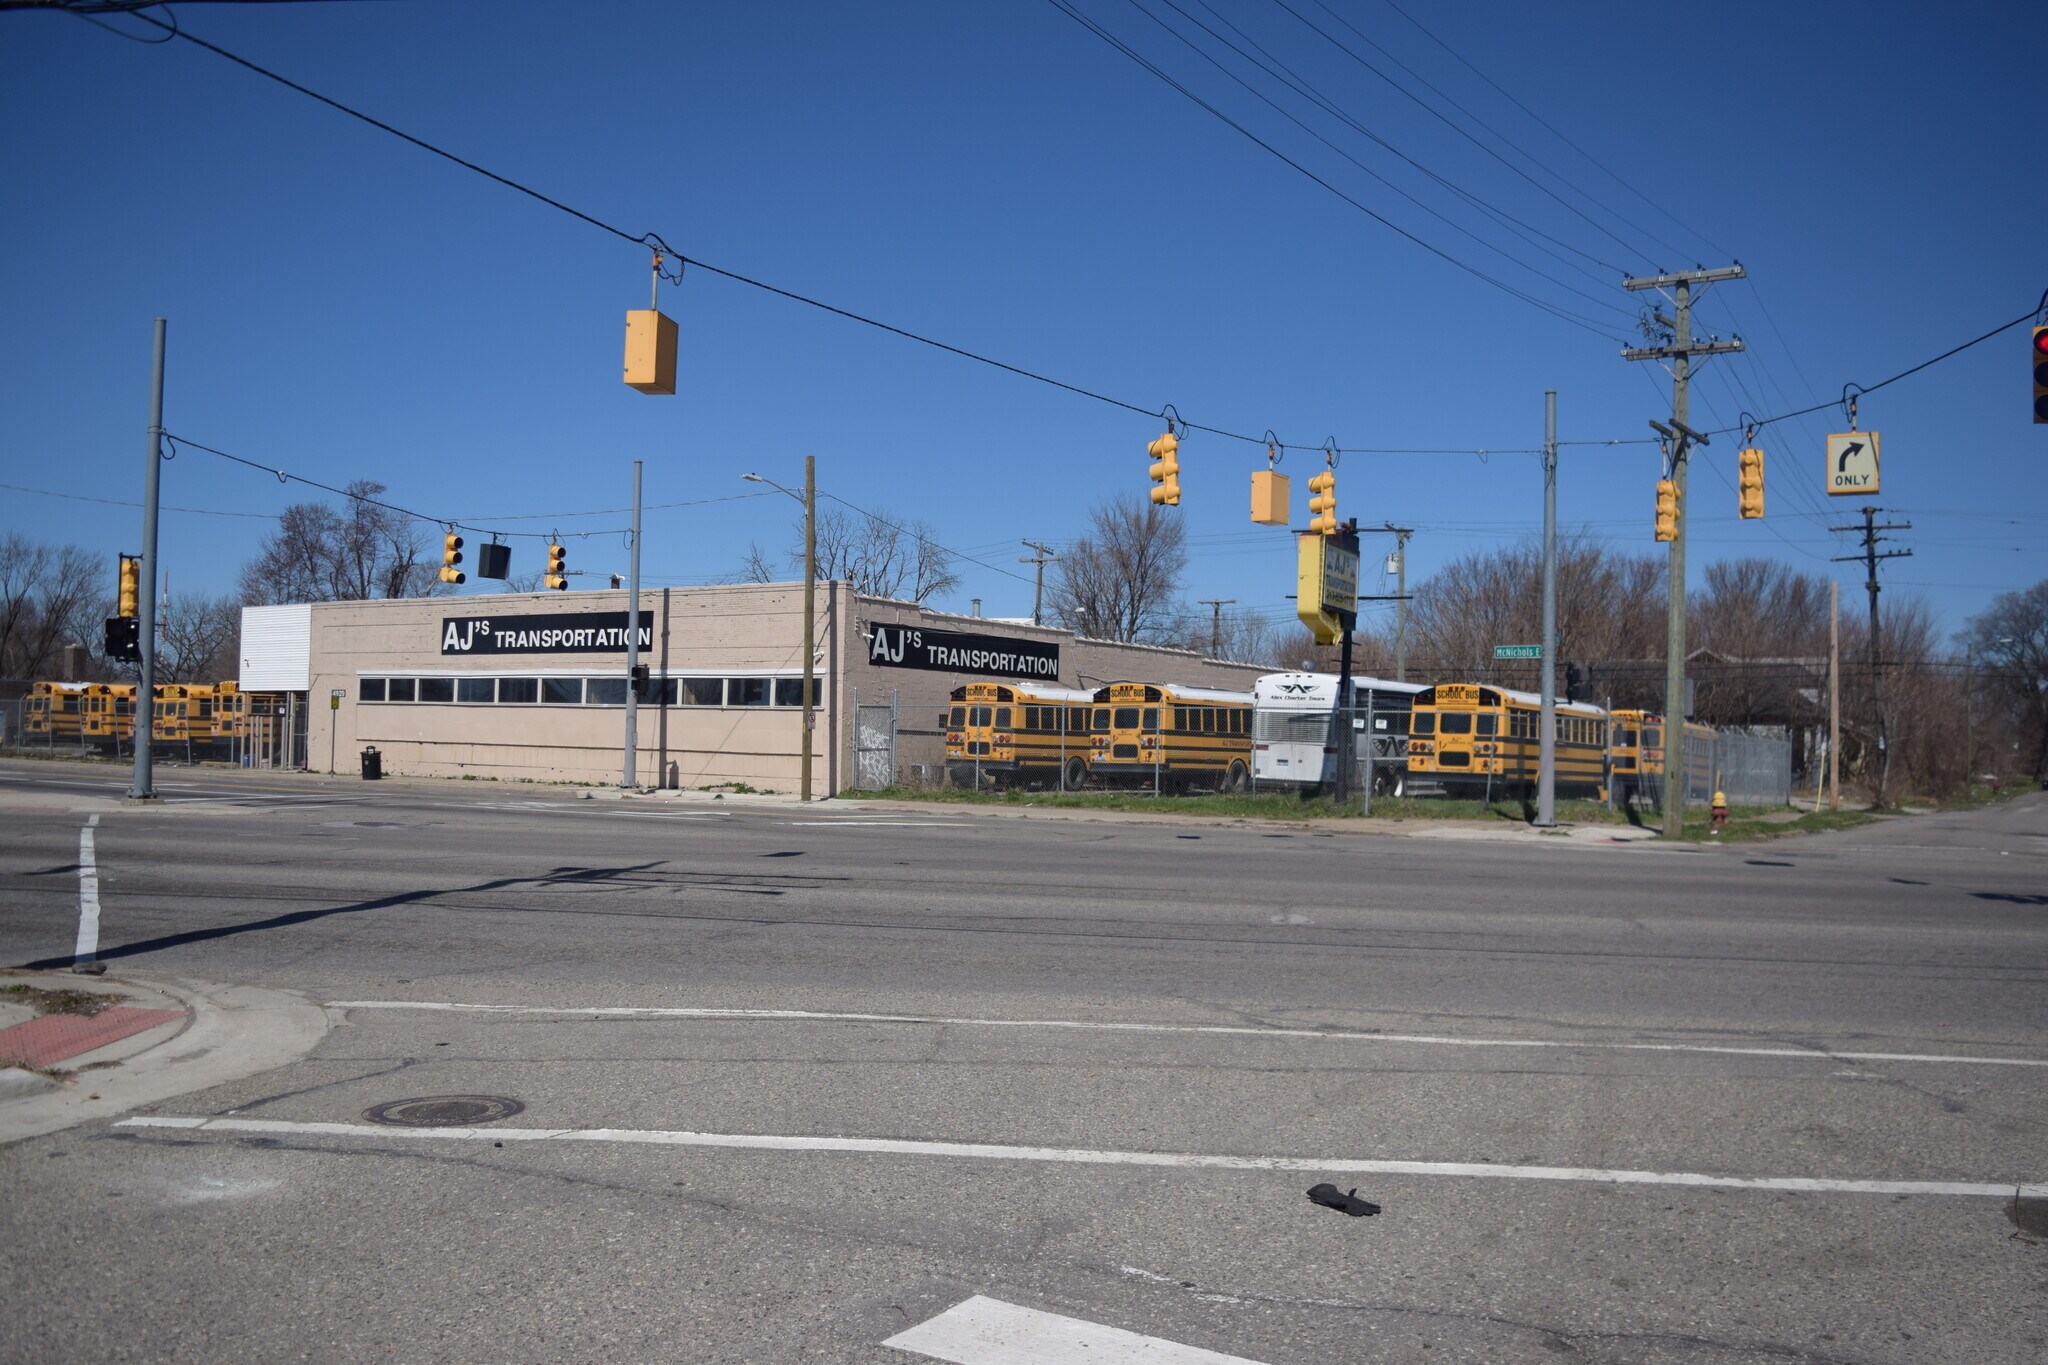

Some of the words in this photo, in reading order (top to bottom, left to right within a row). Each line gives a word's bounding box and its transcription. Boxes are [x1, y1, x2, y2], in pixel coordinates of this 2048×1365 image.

[1835, 475, 1869, 486] ONLY
[1496, 647, 1533, 657] McNichols
[927, 645, 1058, 675] TRANSPORTATION
[967, 688, 985, 697] SCHOOL
[987, 688, 997, 697] BUS
[1111, 688, 1132, 698] SCHOOL
[1134, 688, 1145, 698] BUS
[1437, 690, 1462, 699] SCHOOL
[1465, 690, 1479, 699] BUS
